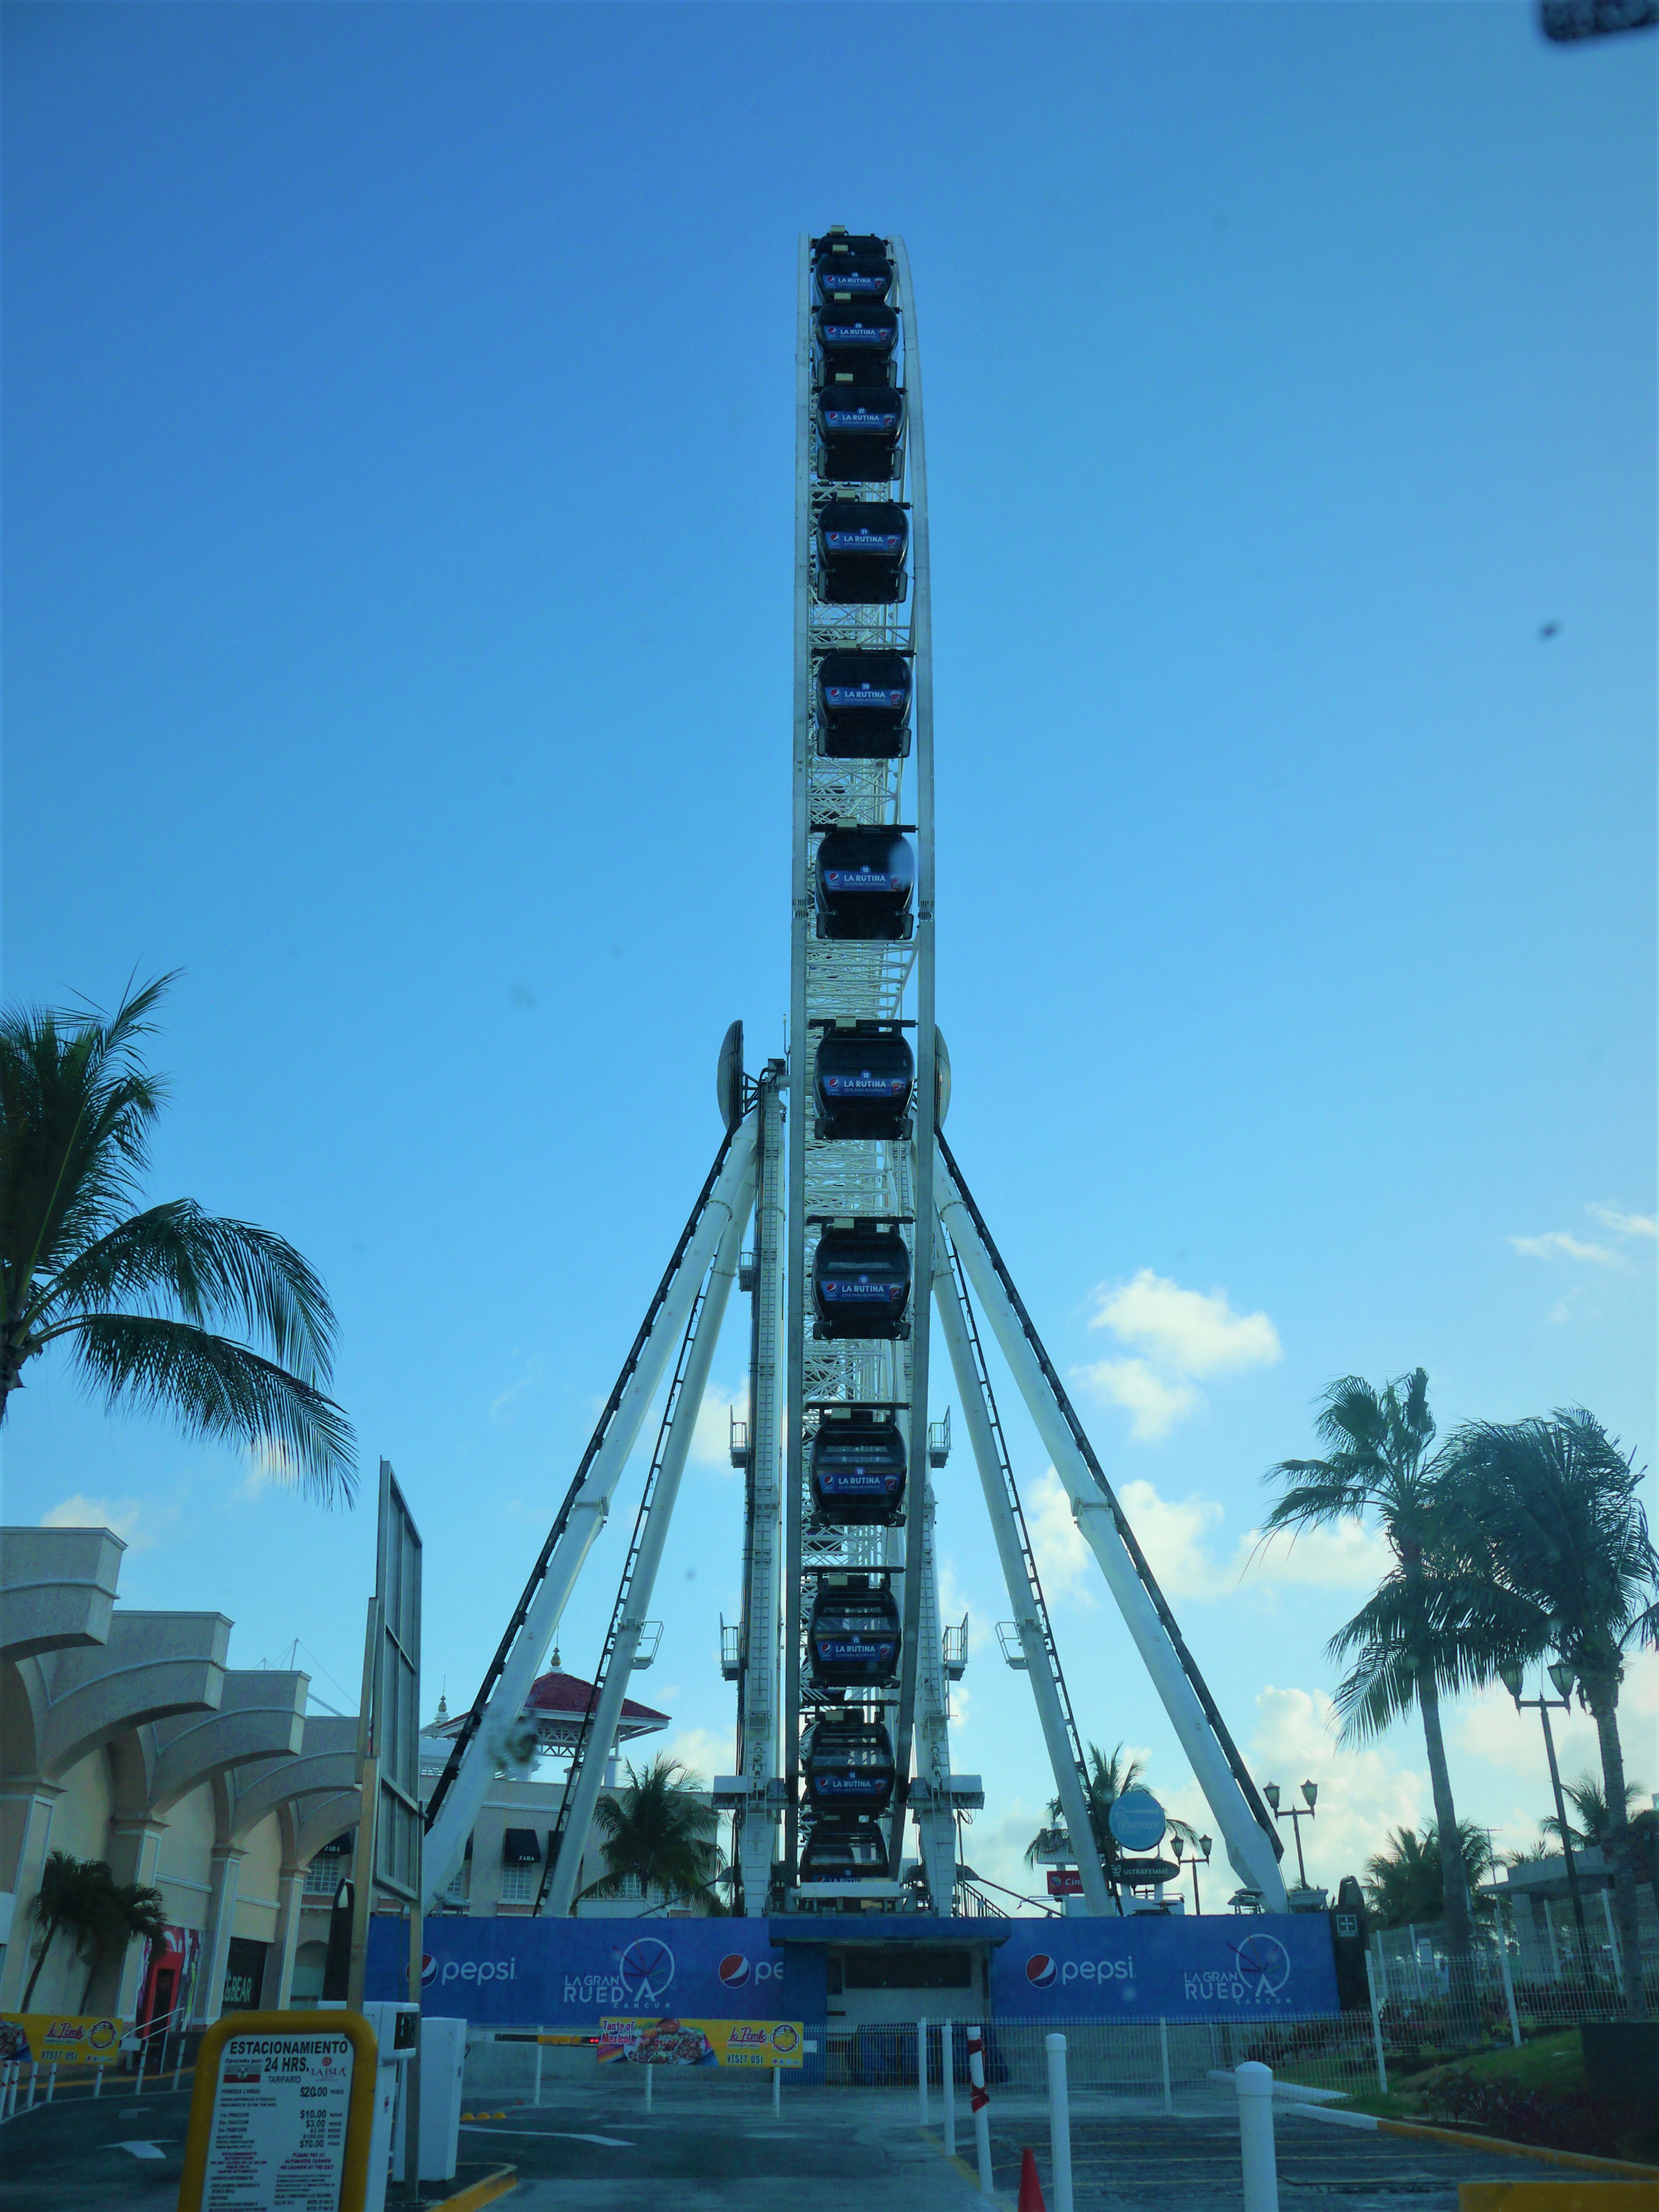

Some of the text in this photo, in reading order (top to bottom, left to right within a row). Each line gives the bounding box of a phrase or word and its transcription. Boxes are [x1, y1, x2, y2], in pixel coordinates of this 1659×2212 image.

[1118, 1821, 1160, 1830] LIGHTHOUSE
[442, 1957, 516, 1985] pepsi
[1062, 1956, 1133, 1985] pepsi
[565, 1975, 619, 1986] LA GRAN
[1184, 1972, 1238, 1982] LA GRAN
[224, 1975, 252, 2002] &BEAR
[603, 2020, 635, 2031] Taste of
[230, 2041, 348, 2054] ESTACIONAMIENTO
[42, 2050, 62, 2060] VISIT
[727, 2055, 763, 2064] VISIT US!
[264, 2057, 309, 2072] 24 HRS.
[311, 2067, 346, 2077] LA ISLA
[300, 2086, 327, 2097] $20.00
[300, 2110, 326, 2119] $10.00
[306, 2119, 325, 2128] $3.00
[300, 2140, 324, 2148] $70.00
